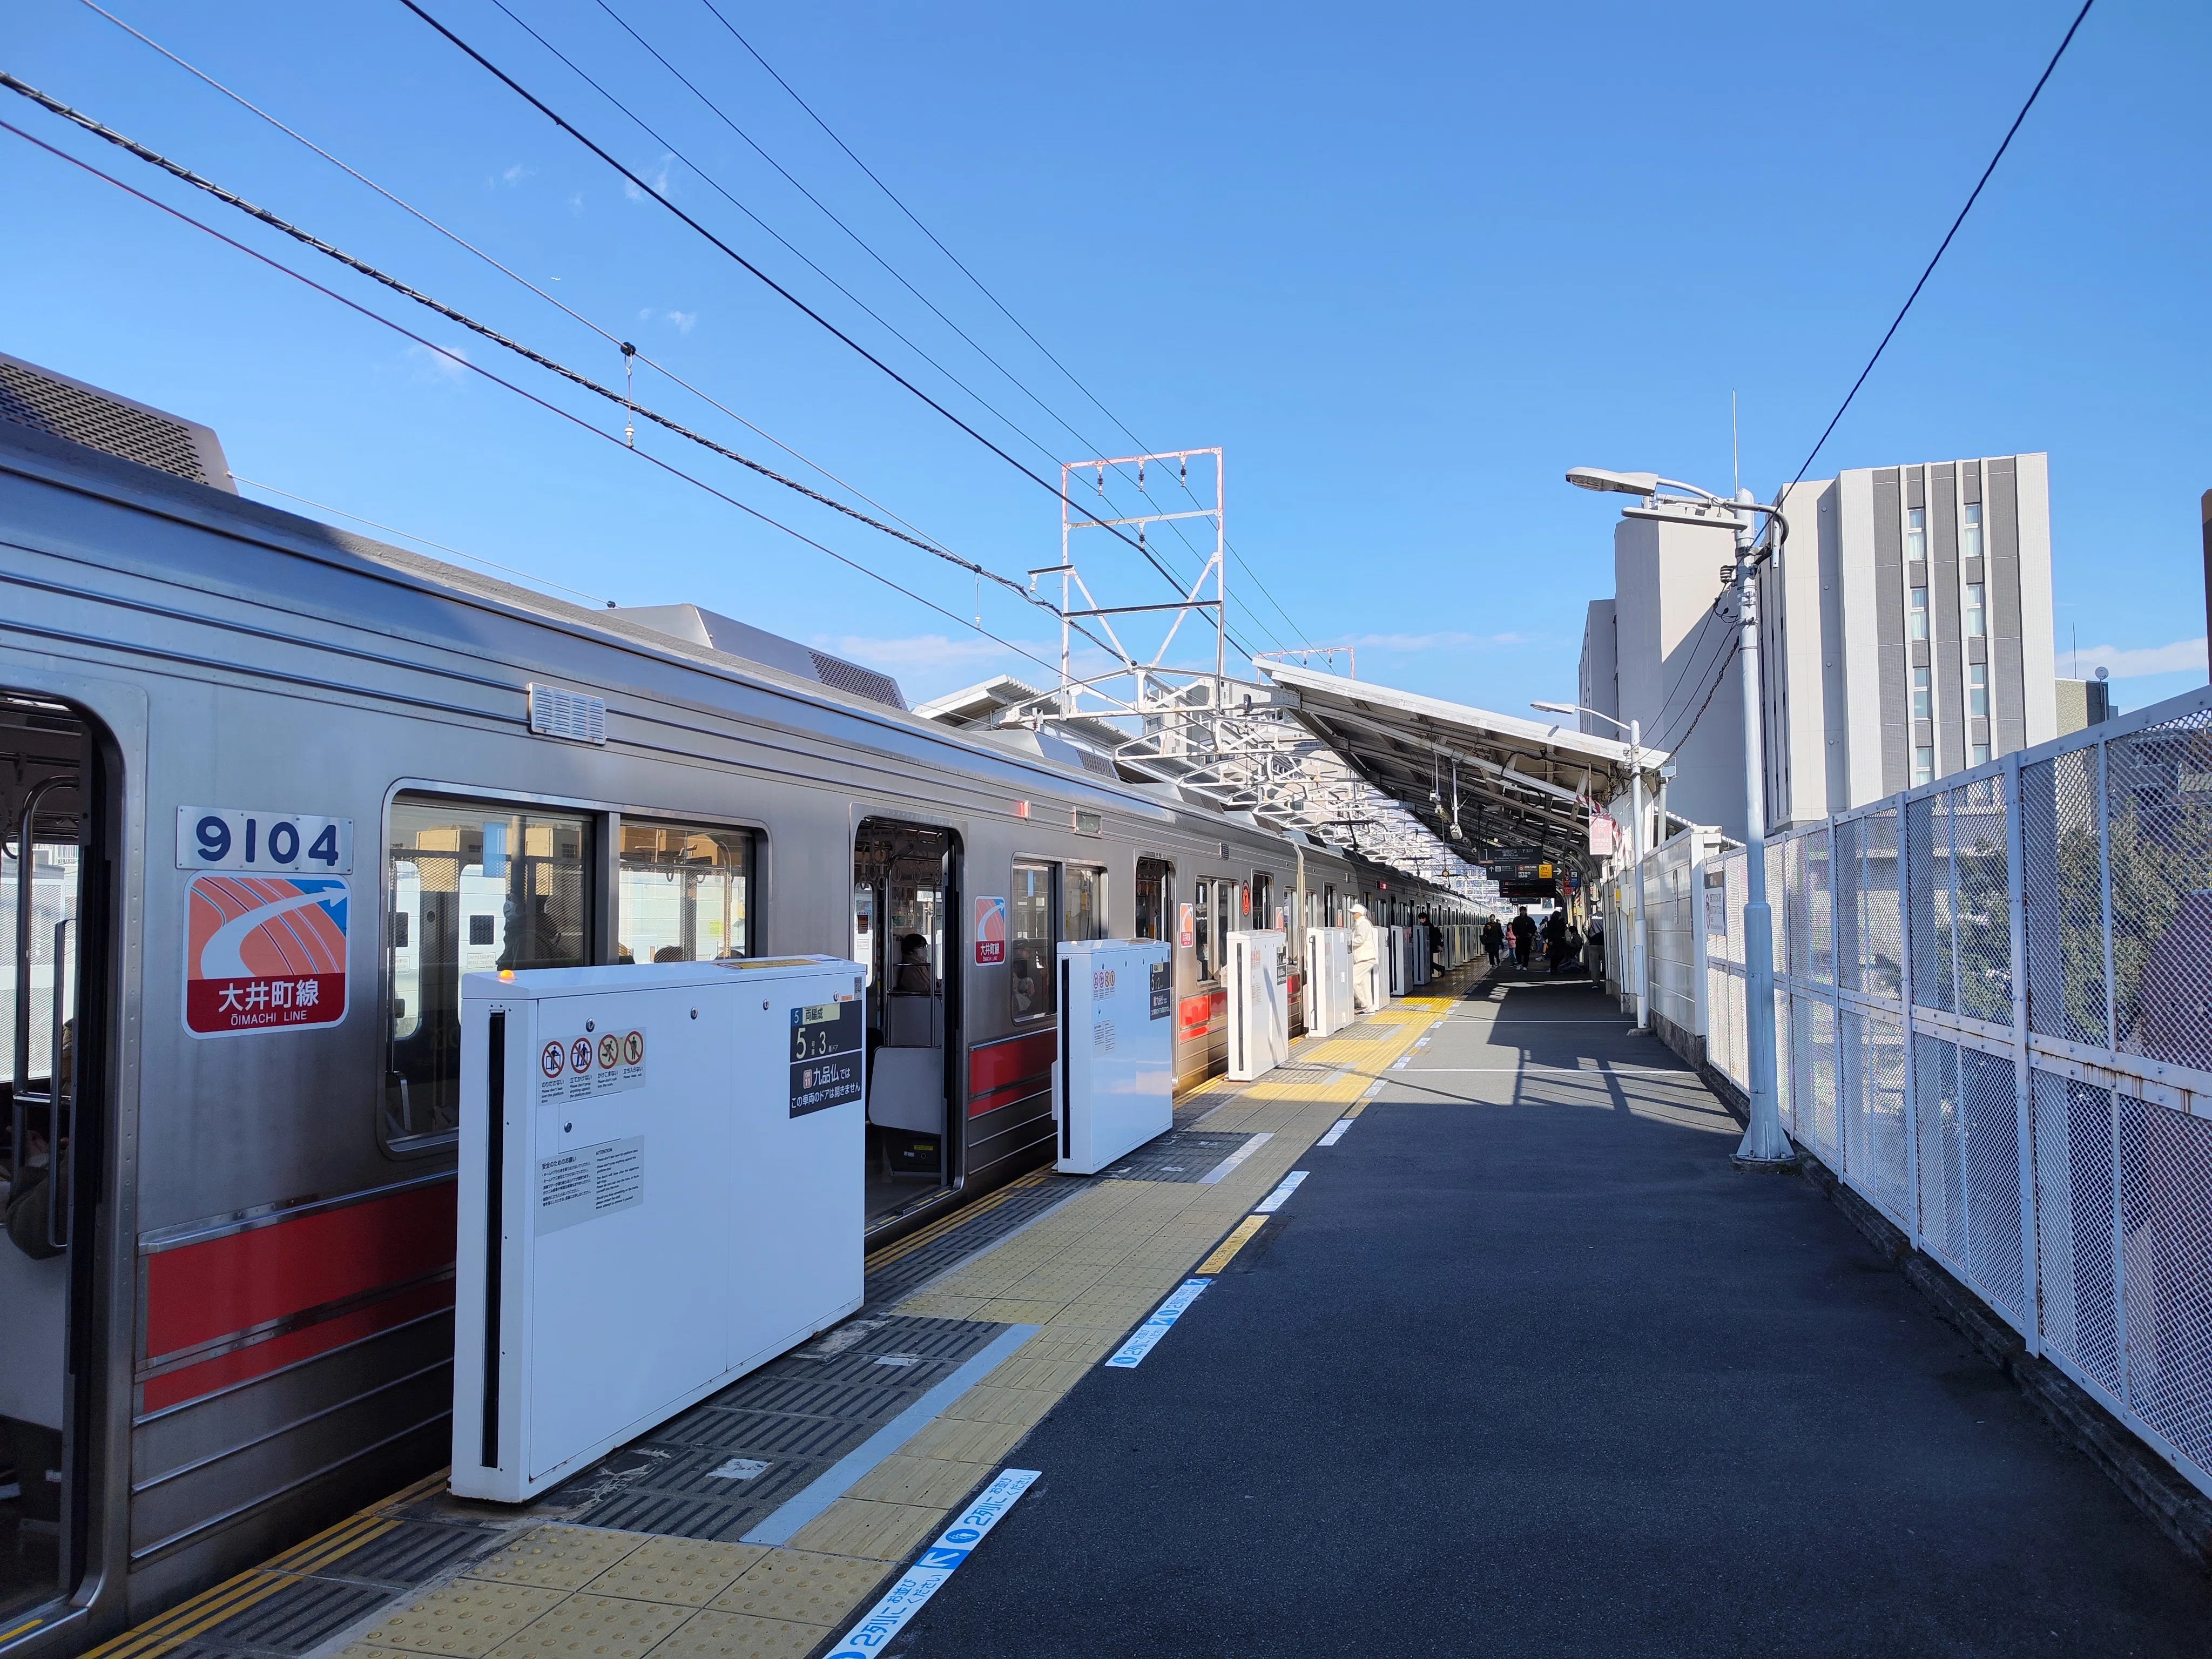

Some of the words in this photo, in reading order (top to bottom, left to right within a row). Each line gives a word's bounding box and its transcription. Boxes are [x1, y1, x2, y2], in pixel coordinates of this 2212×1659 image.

[196, 815, 339, 866] 9104
[1483, 848, 1488, 860] 1
[980, 942, 1000, 955] 大井町線
[1151, 974, 1155, 991] 5
[1157, 977, 1161, 989] 2
[218, 979, 319, 1013] 大井町線
[231, 1012, 276, 1026] ŌIMACHI
[284, 1010, 307, 1021] LINE
[794, 1010, 799, 1023] 5
[805, 1008, 823, 1022] 両編成
[796, 1027, 806, 1059] 5
[819, 1031, 826, 1054] 3
[805, 1077, 810, 1087] 11
[813, 1063, 851, 1086] 九品仏では
[792, 1082, 860, 1108] この車両のドアは開きません
[1123, 1339, 1150, 1355] 2列に
[989, 1477, 1013, 1494] お並び
[1007, 1474, 1033, 1496] ください
[963, 1496, 1007, 1526] 2列に
[887, 1579, 917, 1604] お並び
[907, 1574, 943, 1604] ください
[849, 1607, 907, 1647] 2列に
